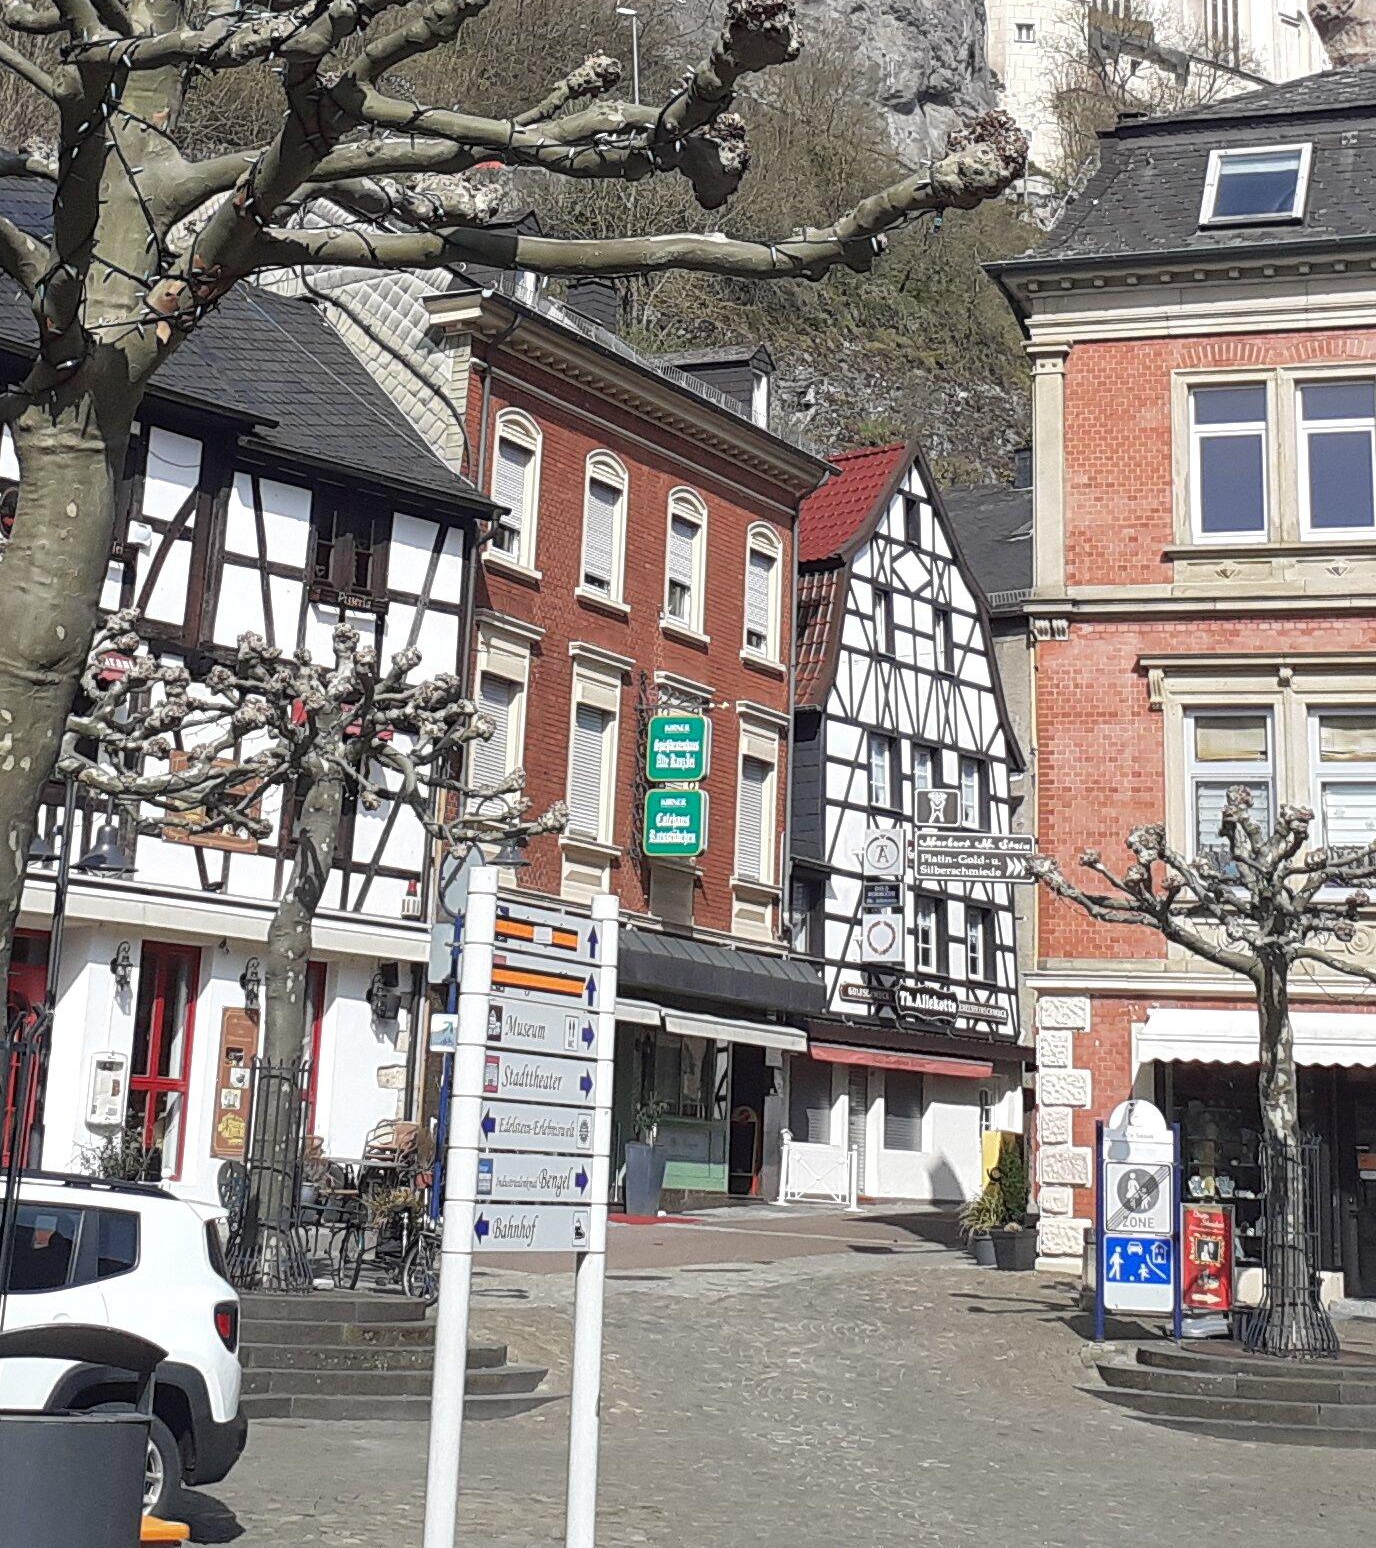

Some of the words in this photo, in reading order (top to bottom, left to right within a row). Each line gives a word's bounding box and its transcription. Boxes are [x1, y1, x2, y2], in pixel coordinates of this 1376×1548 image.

[919, 864, 1002, 877] Silberschmiede
[505, 1014, 545, 1040] Museum
[501, 1063, 563, 1091] Stadttheater
[538, 1166, 574, 1198] Bengel
[492, 1215, 539, 1247] Bahnhof
[1123, 1216, 1155, 1229] ZONE
